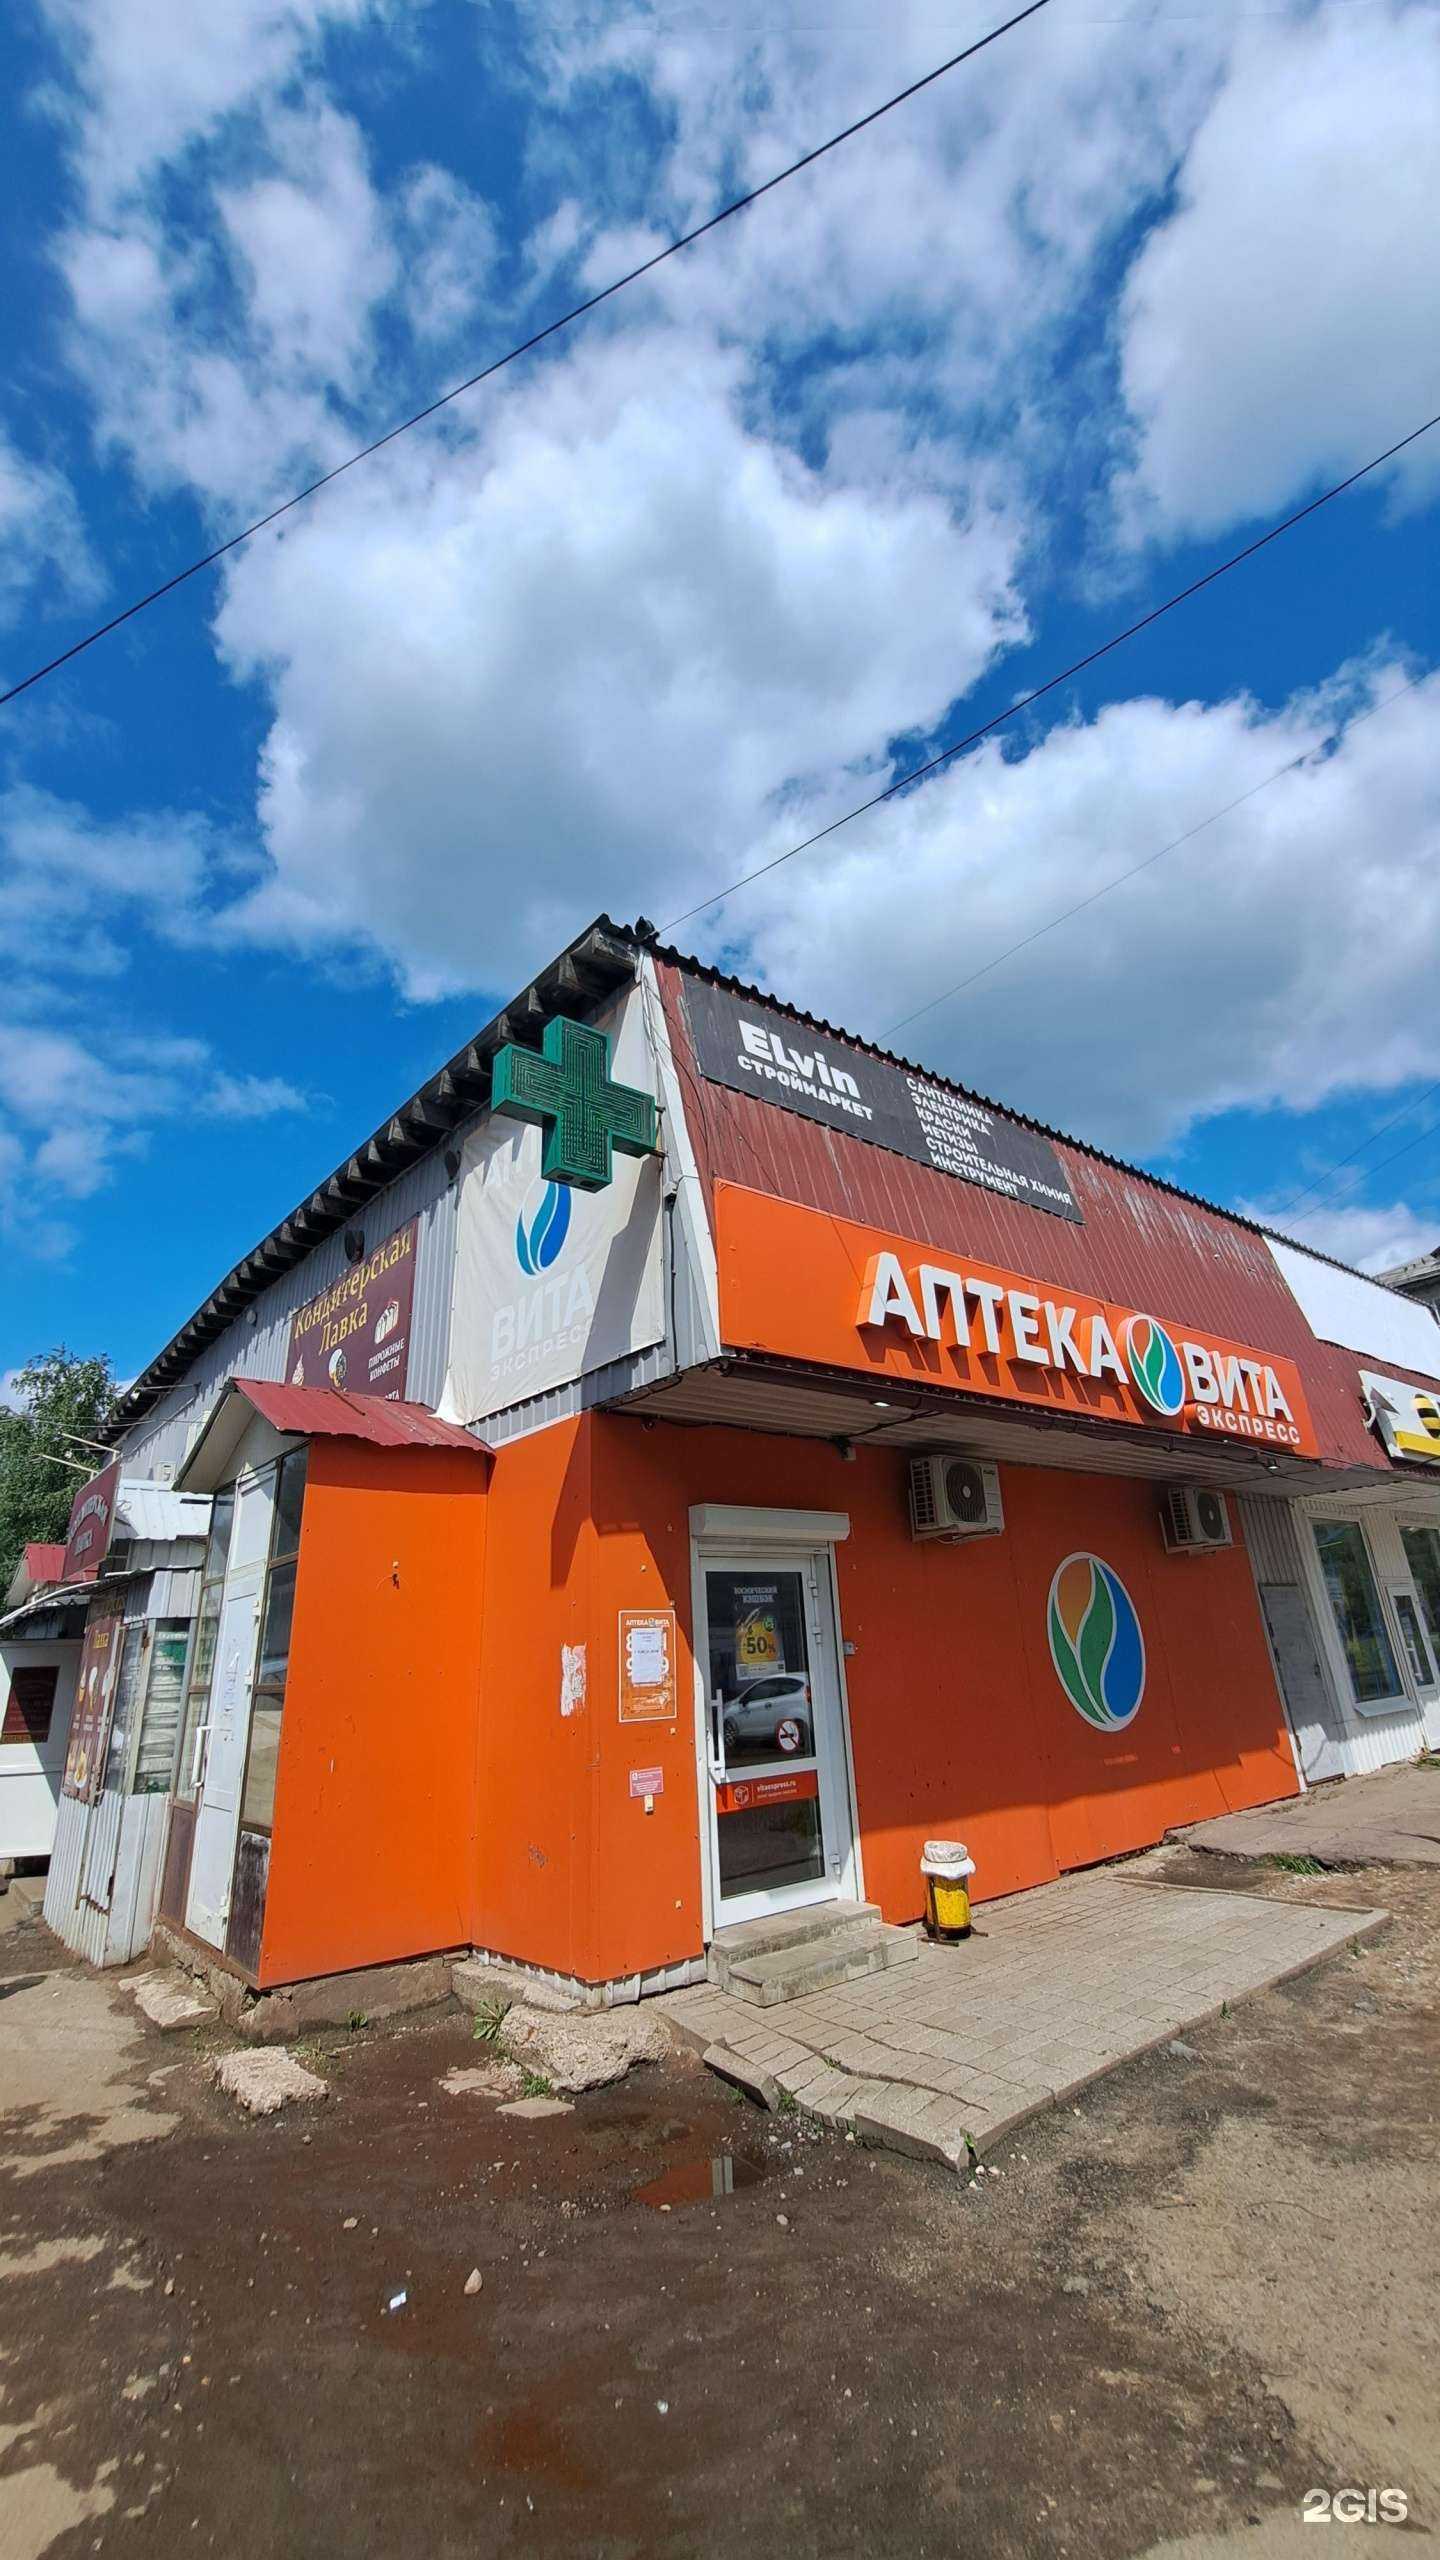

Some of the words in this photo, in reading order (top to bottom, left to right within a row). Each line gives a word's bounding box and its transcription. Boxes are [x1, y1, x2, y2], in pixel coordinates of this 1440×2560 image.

[738, 1055, 873, 1120] СТРОЙМАРКЕТ
[906, 1077, 995, 1126] САНТЕХНИКА
[911, 1092, 991, 1136] ЭЛЕКТРИКА
[916, 1106, 972, 1139] КРАСКИ
[921, 1121, 978, 1154] МЕТИЗЫ
[926, 1137, 1030, 1187] СТРОИТЕЛЬНАЯ
[1030, 1178, 1073, 1206] ХИМИЯ
[930, 1151, 1019, 1195] ИНСТРУМЕНТ
[295, 1230, 411, 1341] Кондитерская
[318, 1302, 368, 1355] Лавка
[492, 1263, 592, 1361] ВИТА
[868, 1251, 1129, 1384] АПТЕКА
[1183, 1341, 1294, 1422] ВИТА
[369, 1355, 400, 1381] КОНФЕТЫ
[1196, 1406, 1300, 1443] ЭКСПРЕСС
